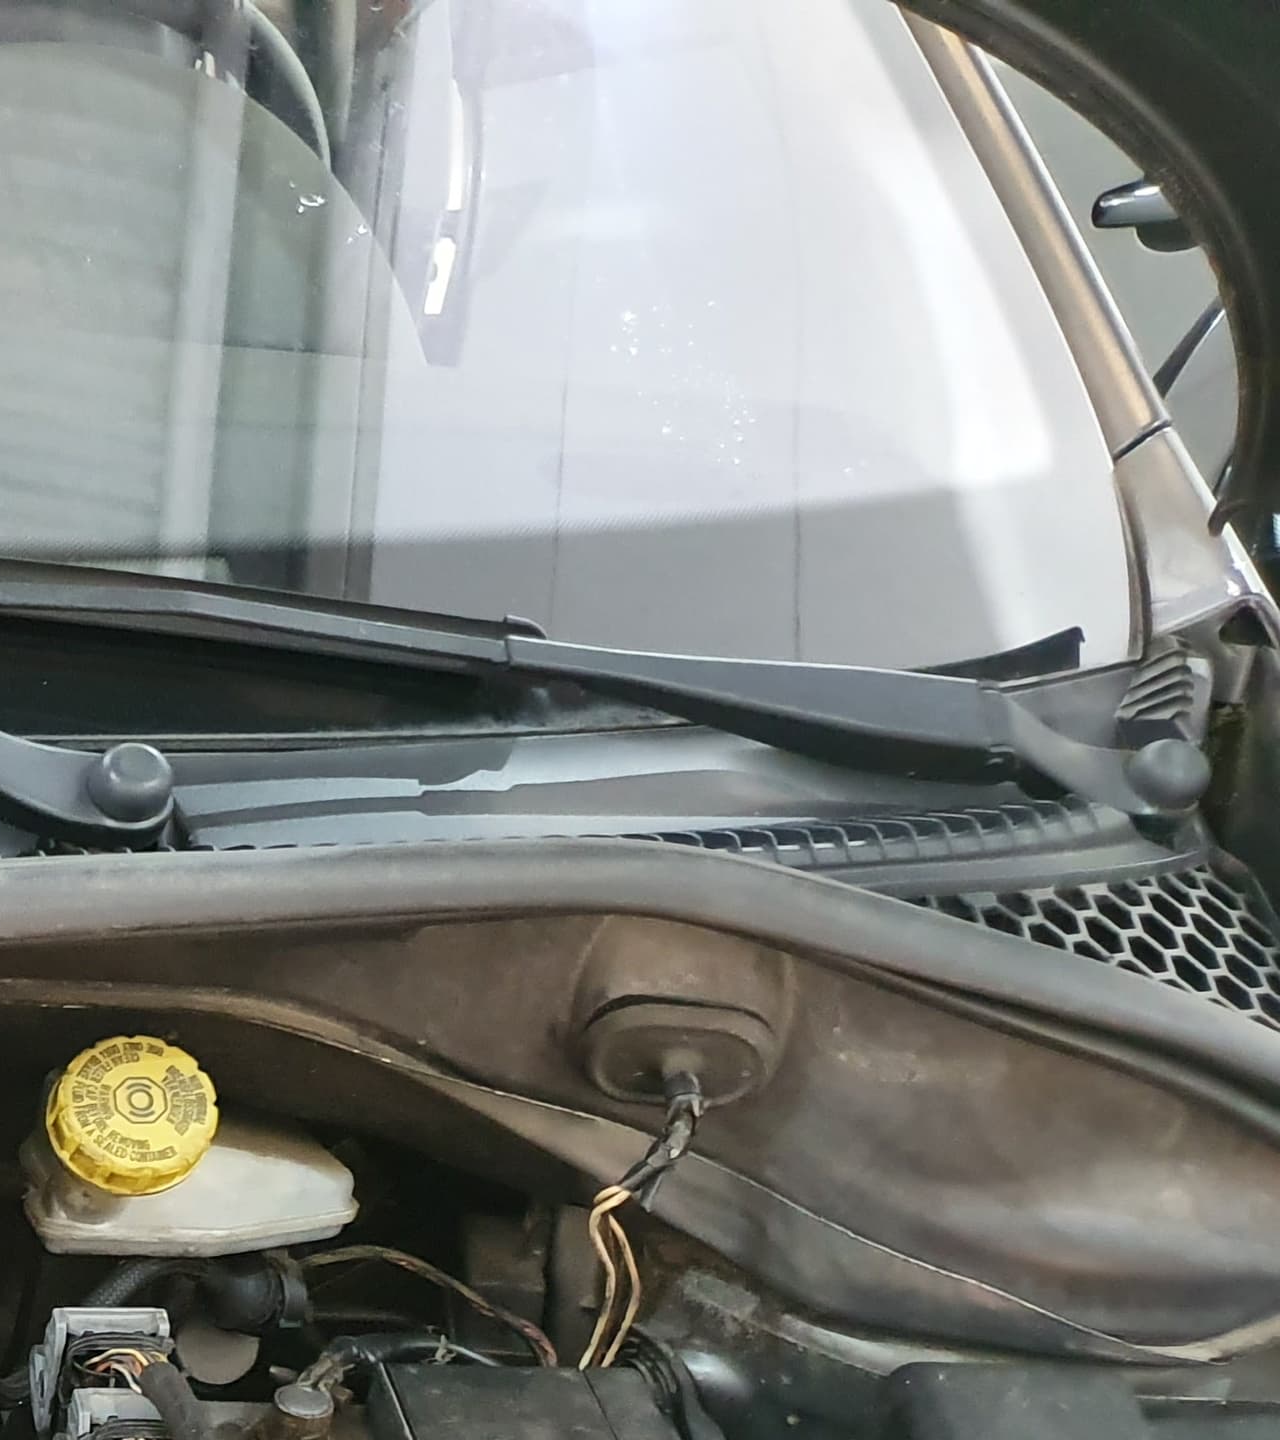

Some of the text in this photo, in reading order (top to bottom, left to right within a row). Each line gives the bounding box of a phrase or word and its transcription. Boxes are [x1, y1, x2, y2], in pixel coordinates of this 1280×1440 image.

[72, 1080, 86, 1103] FLUID
[85, 1084, 98, 1101] CAP
[73, 1104, 91, 1128] FROM
[93, 1135, 128, 1158] SEALED
[129, 1145, 178, 1162] CONTAINER
